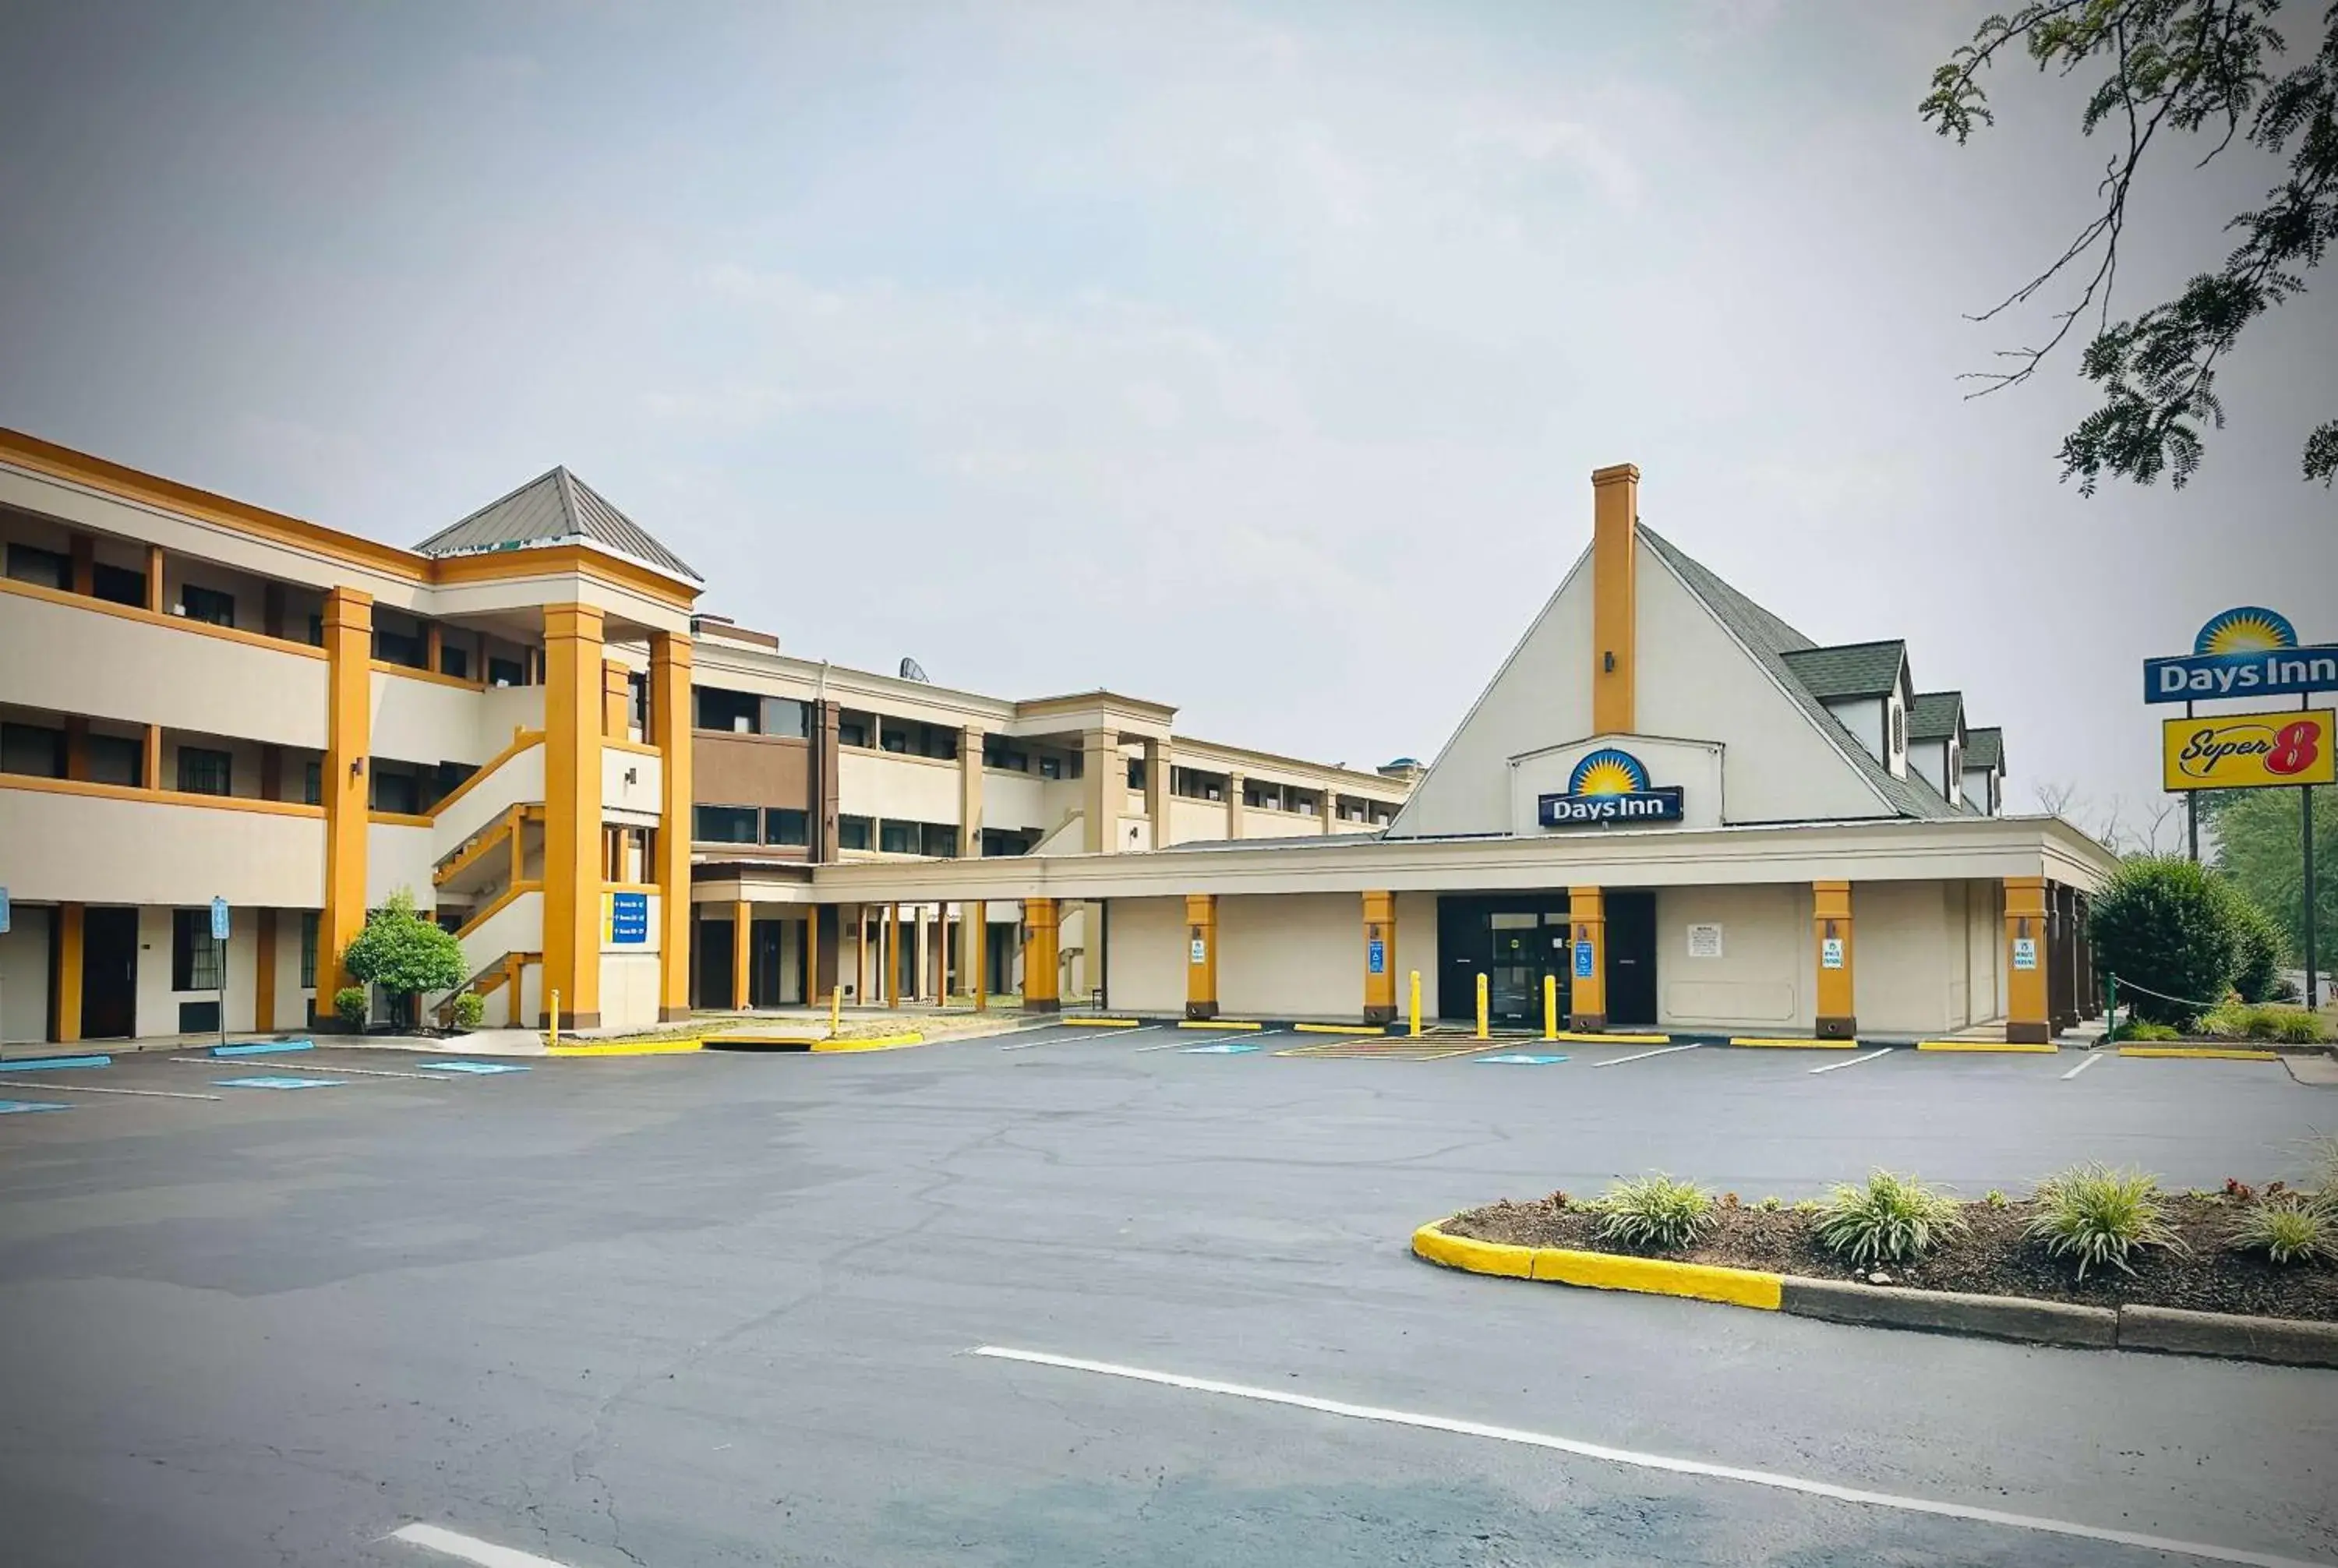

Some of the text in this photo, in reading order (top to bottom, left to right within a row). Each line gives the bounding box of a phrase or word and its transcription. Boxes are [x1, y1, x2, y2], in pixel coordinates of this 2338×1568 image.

[2160, 658, 2336, 693] Days Inn
[2180, 721, 2322, 775] Super 8
[1553, 797, 1664, 819] Days Inn
